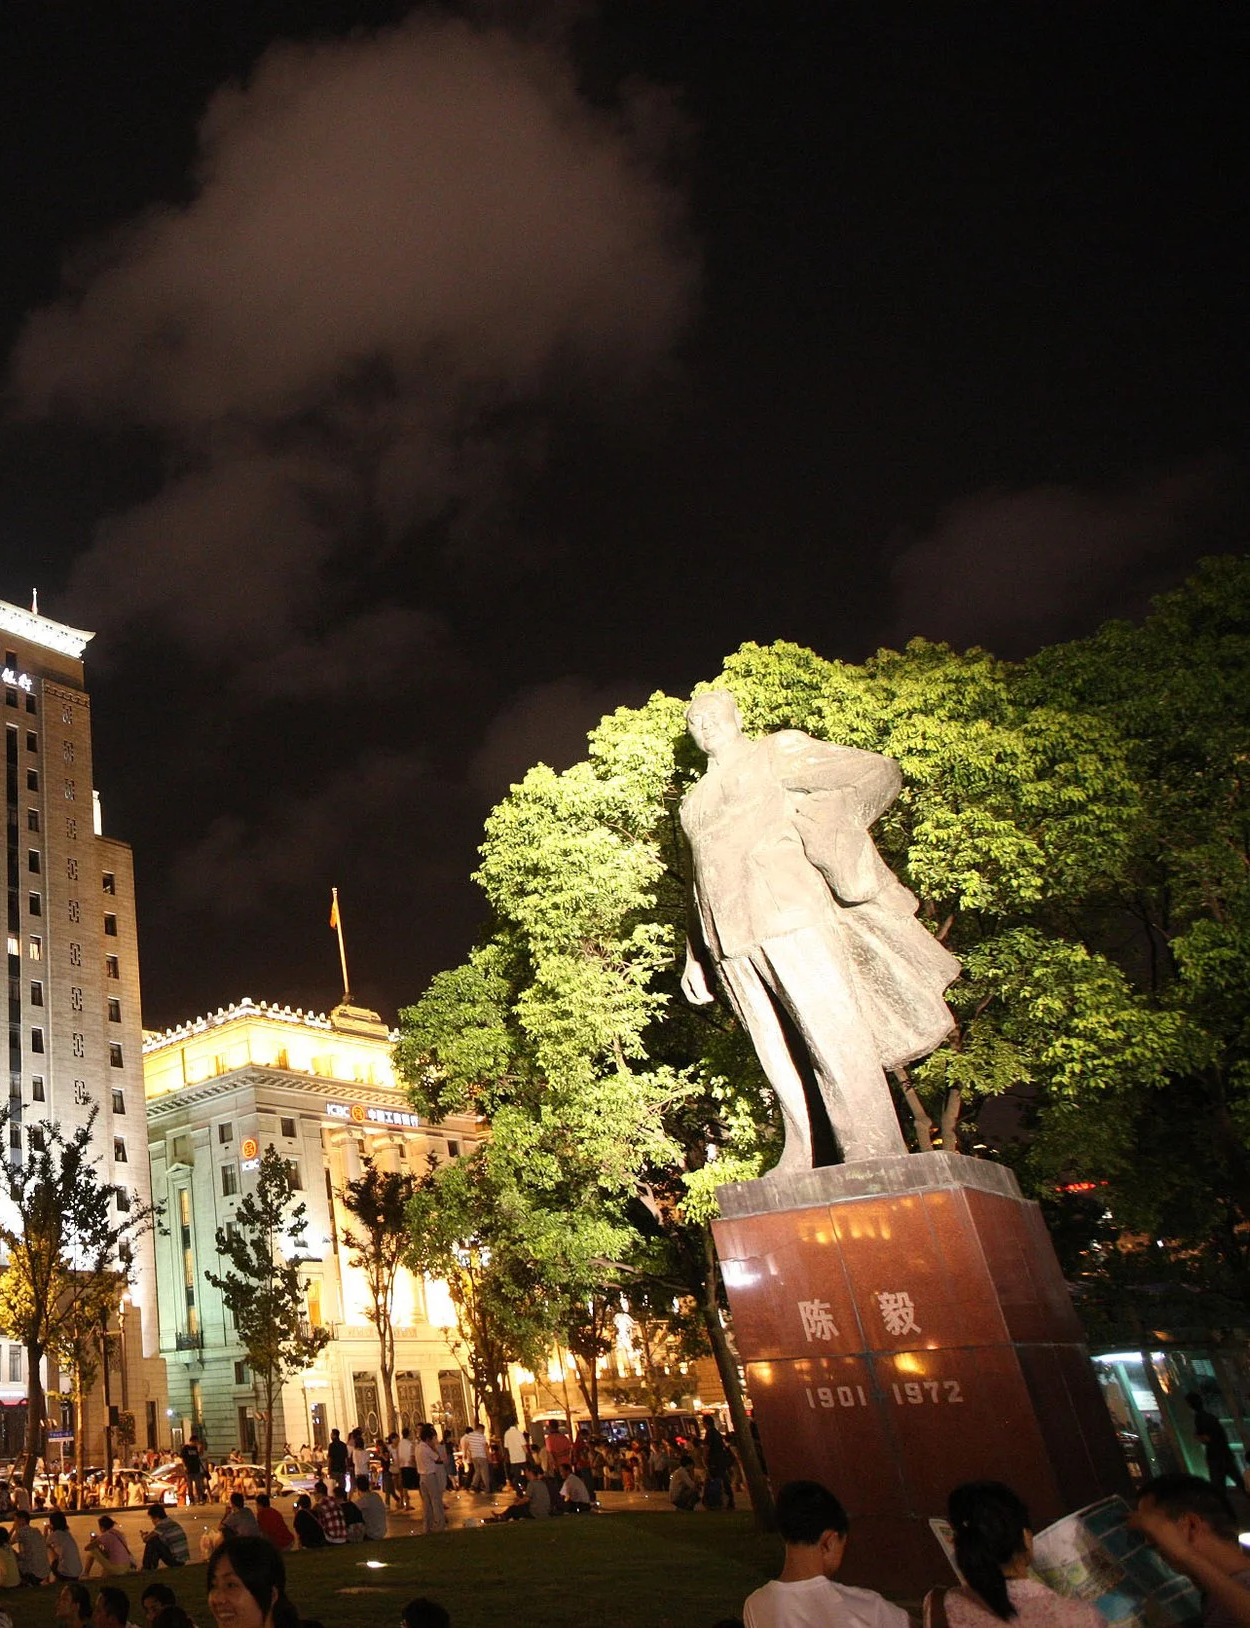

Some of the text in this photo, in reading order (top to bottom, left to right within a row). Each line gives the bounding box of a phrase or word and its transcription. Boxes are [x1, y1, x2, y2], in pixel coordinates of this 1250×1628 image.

[797, 1291, 922, 1342] 陈毅
[805, 1381, 964, 1409] 1901 1972
